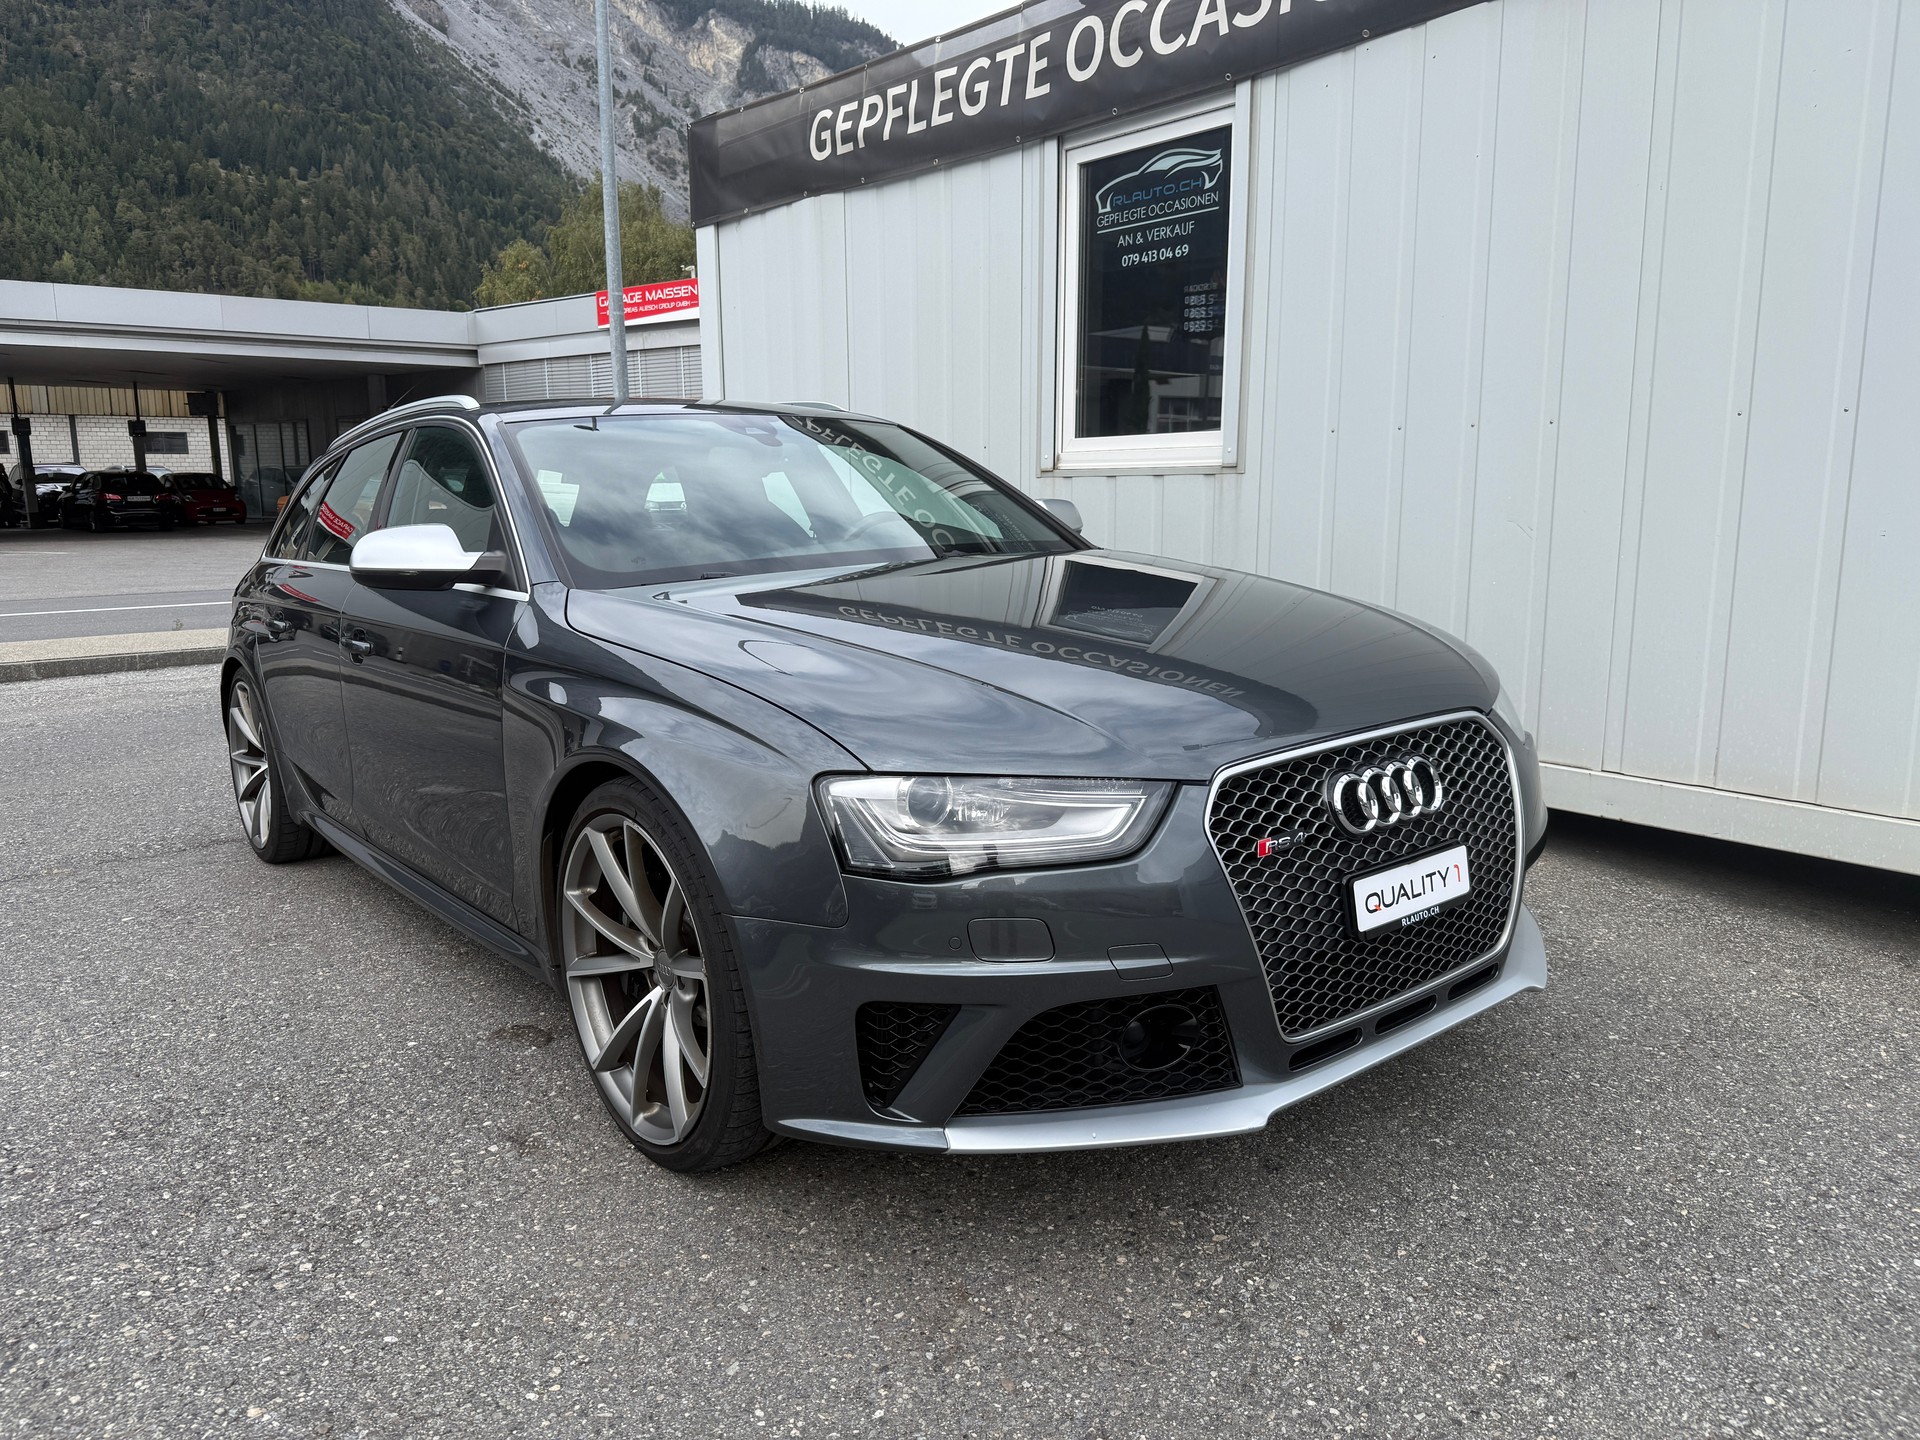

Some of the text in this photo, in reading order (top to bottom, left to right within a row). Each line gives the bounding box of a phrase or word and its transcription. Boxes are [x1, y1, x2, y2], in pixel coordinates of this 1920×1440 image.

[809, 0, 1330, 161] GEPFLEGTE OCCA
[1112, 178, 1202, 207] RLAUTO.CH
[1096, 191, 1219, 228] GEPFLEGTE OCCASIONEN
[1117, 221, 1195, 247] AN & VERKAUF
[1121, 244, 1189, 268] 079 413 04 69
[598, 284, 698, 307] GAGE MAISSEN
[658, 302, 676, 310] GROUP
[1364, 863, 1461, 914] QUALITY 1
[1401, 905, 1440, 927] RLAUTO.CH
